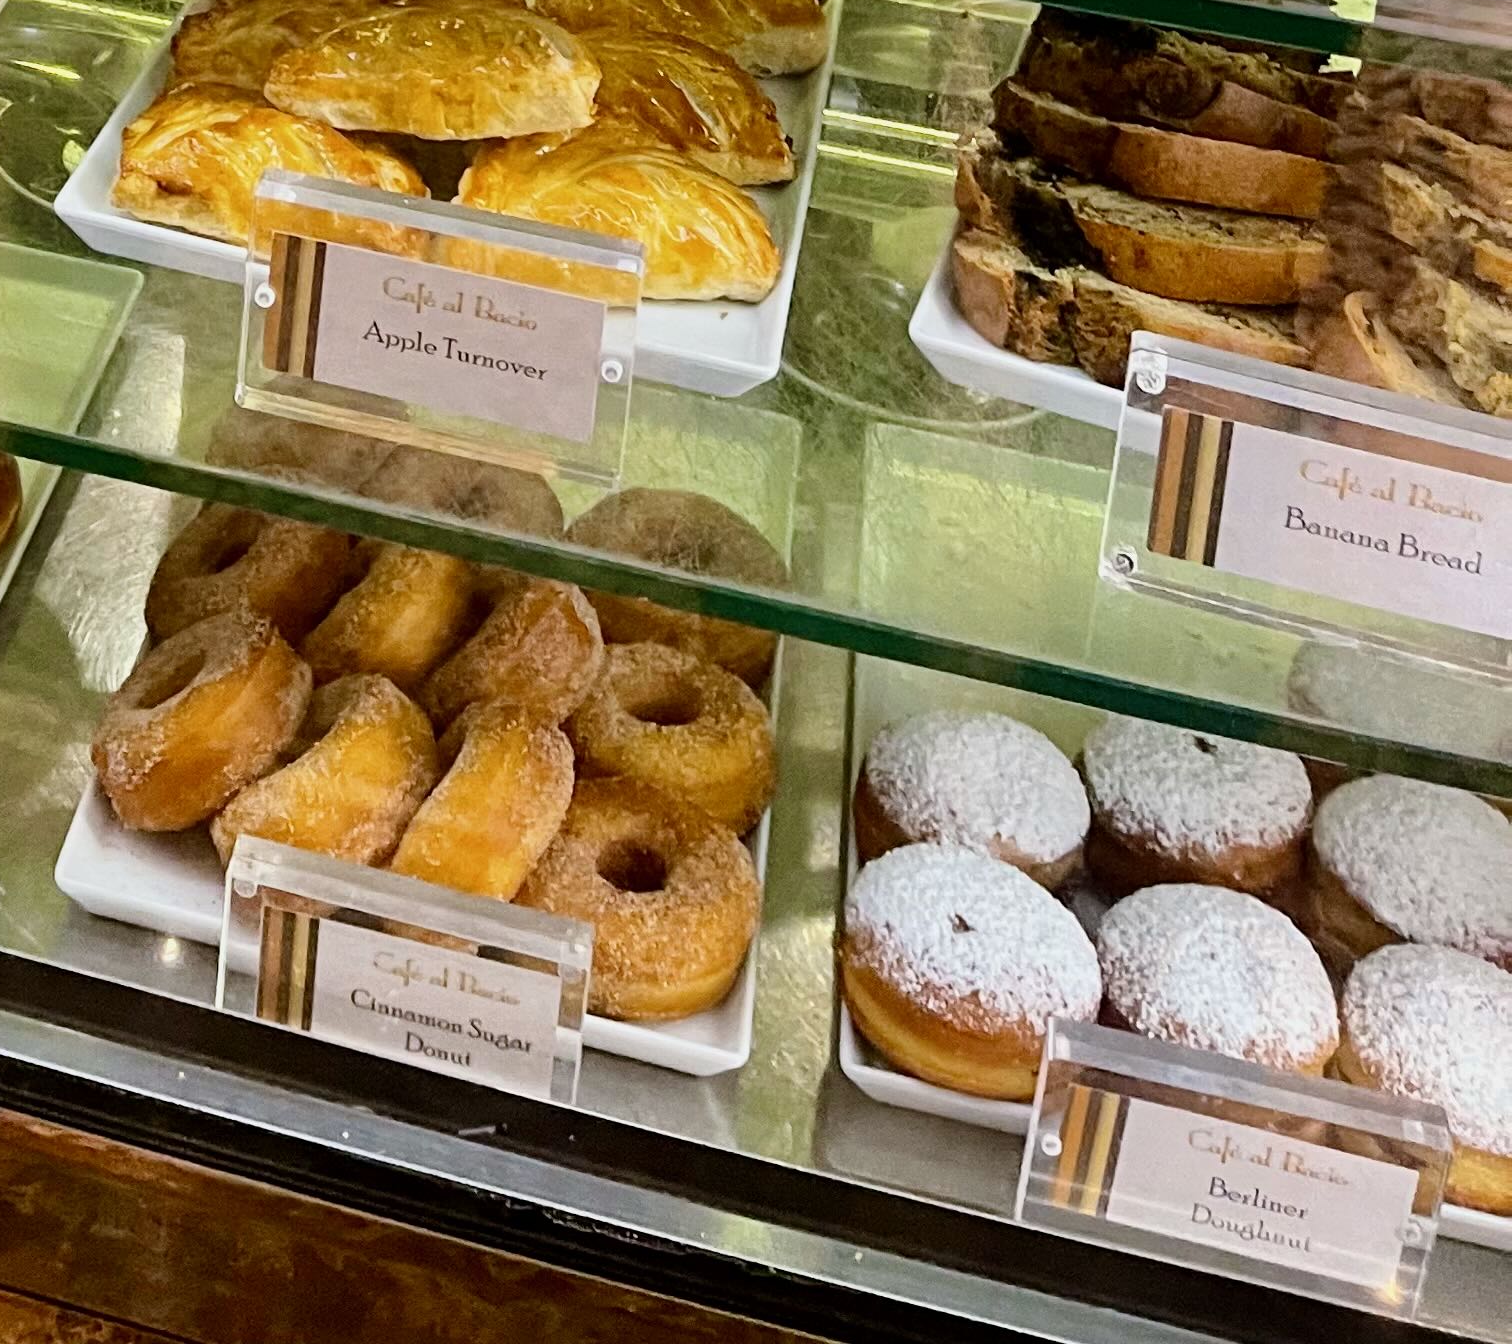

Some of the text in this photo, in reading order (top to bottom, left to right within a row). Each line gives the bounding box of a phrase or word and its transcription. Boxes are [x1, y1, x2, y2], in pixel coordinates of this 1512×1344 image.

[383, 276, 537, 331] Café al Bacio
[362, 320, 548, 381] Apple Turnover
[1299, 459, 1364, 501] Café
[1370, 477, 1395, 502] al
[1284, 505, 1483, 576] Banana Bread
[350, 988, 532, 1053] Cinnamon Sugar
[405, 1031, 471, 1067] Donut
[1249, 1147, 1272, 1167] al
[1209, 1176, 1308, 1220] Berliner
[1191, 1202, 1312, 1253] Doughnut
